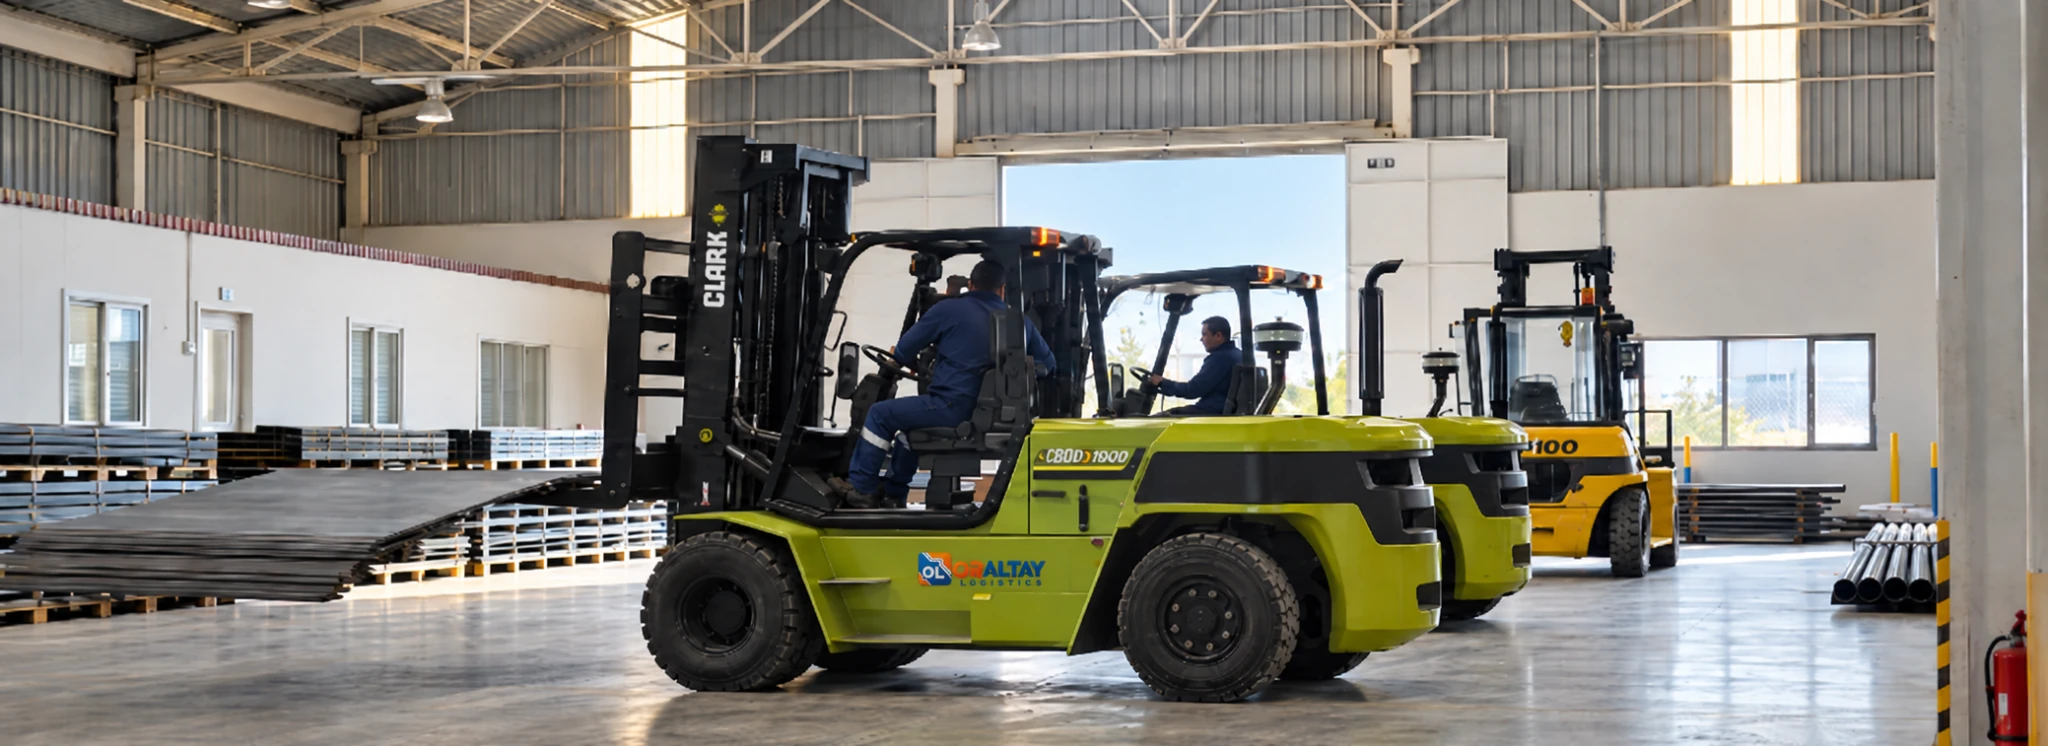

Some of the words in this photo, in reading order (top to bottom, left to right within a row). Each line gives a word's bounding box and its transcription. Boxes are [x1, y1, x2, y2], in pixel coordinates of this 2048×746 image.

[703, 231, 728, 308] CLARK
[922, 566, 945, 579] OL
[952, 560, 1046, 578] ORALTAY
[960, 579, 1042, 587] LOGISTICS
